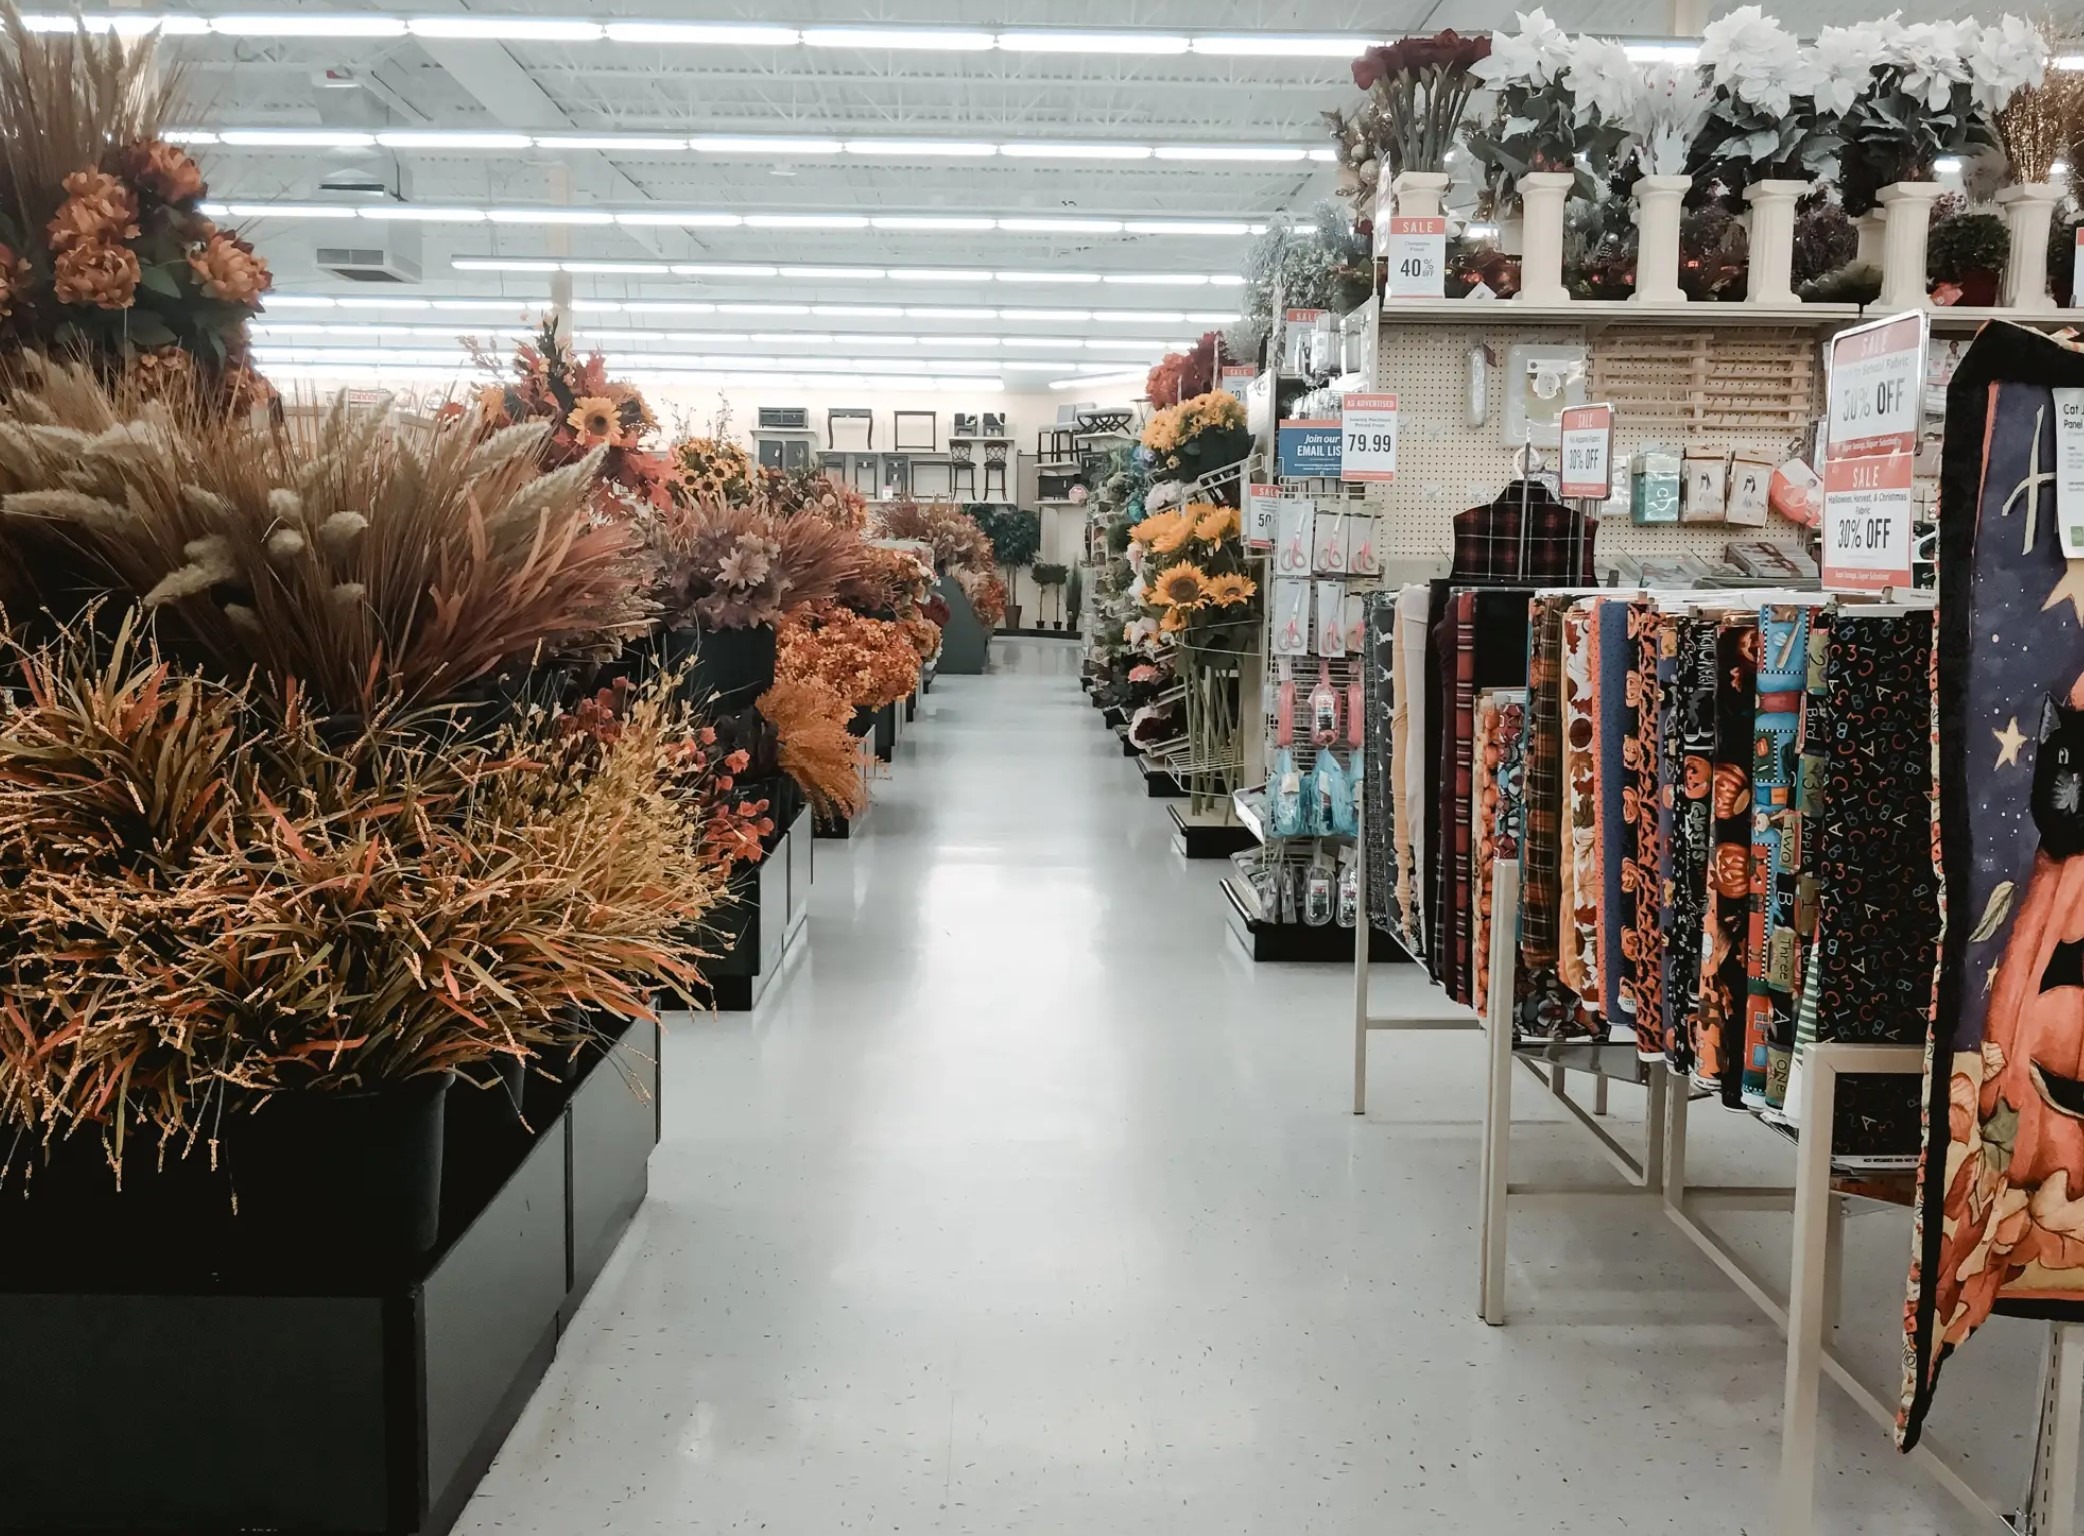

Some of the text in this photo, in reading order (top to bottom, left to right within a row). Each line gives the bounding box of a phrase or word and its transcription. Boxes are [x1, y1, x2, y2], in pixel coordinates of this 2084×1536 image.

[1402, 222, 1433, 233] SALE
[1400, 258, 1420, 277] 40
[1861, 330, 1888, 358] SALE
[1877, 377, 1905, 415] OFF
[2063, 404, 2078, 415] Cat
[1578, 413, 1593, 428] SALE
[2064, 419, 2083, 429] Panel
[1304, 434, 1322, 444] Join
[1348, 434, 1391, 452] 79.99
[1297, 446, 1342, 457] EMAIL LIS
[1586, 448, 1599, 470] OFF
[1852, 466, 1879, 488] SALE
[1856, 506, 1871, 514] Fabric
[1838, 518, 1891, 549] 30% OFF
[1806, 708, 1821, 740] Bird
[1828, 822, 1843, 836] A
[1781, 822, 1794, 863] TWO
[1802, 819, 1817, 865] Apple
[1778, 891, 1793, 906] B
[1780, 939, 1791, 980] Three
[1774, 1008, 1790, 1024] A
